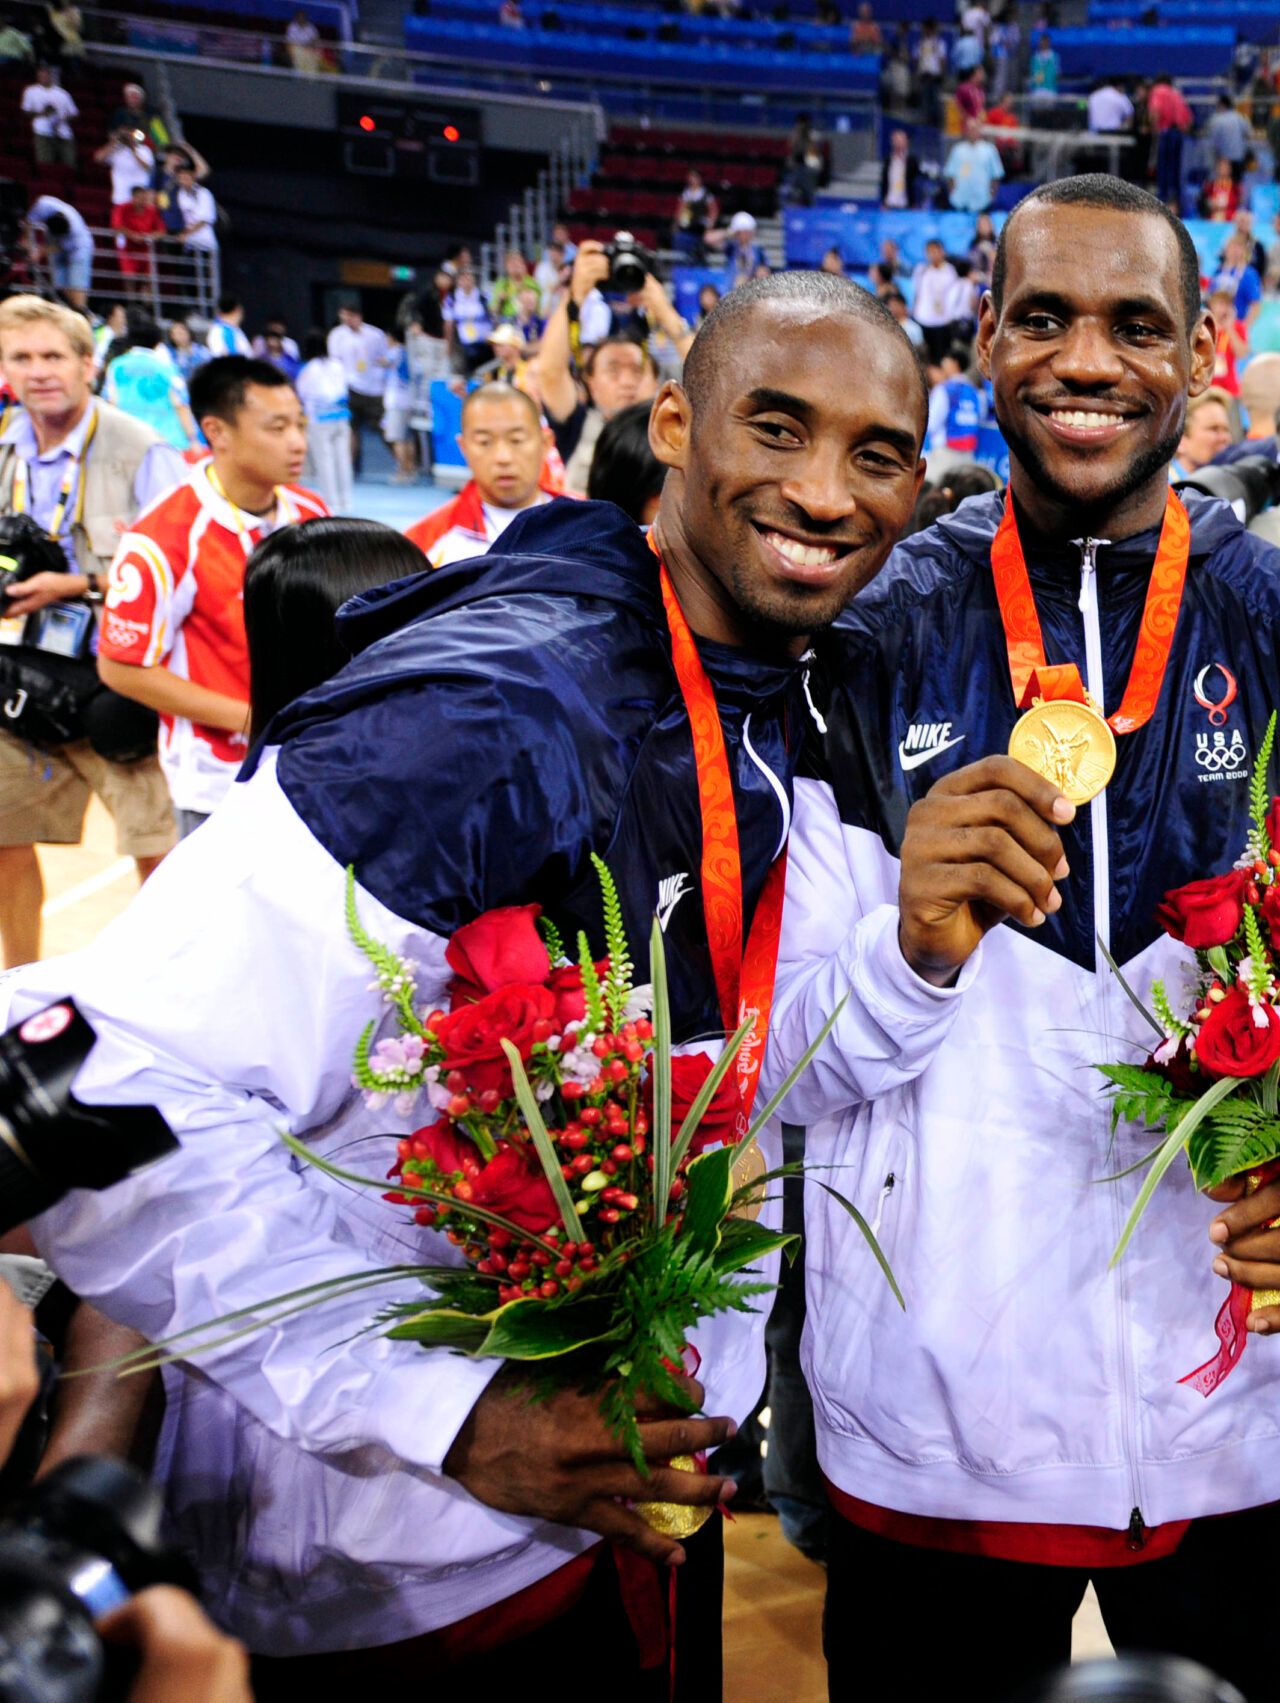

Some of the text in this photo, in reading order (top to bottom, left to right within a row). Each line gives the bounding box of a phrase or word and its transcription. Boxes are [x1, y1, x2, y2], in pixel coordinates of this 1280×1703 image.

[904, 722, 952, 749] NIKE
[1196, 729, 1243, 749] USA
[1197, 772, 1224, 783] TEAM
[658, 872, 689, 910] NIKE
